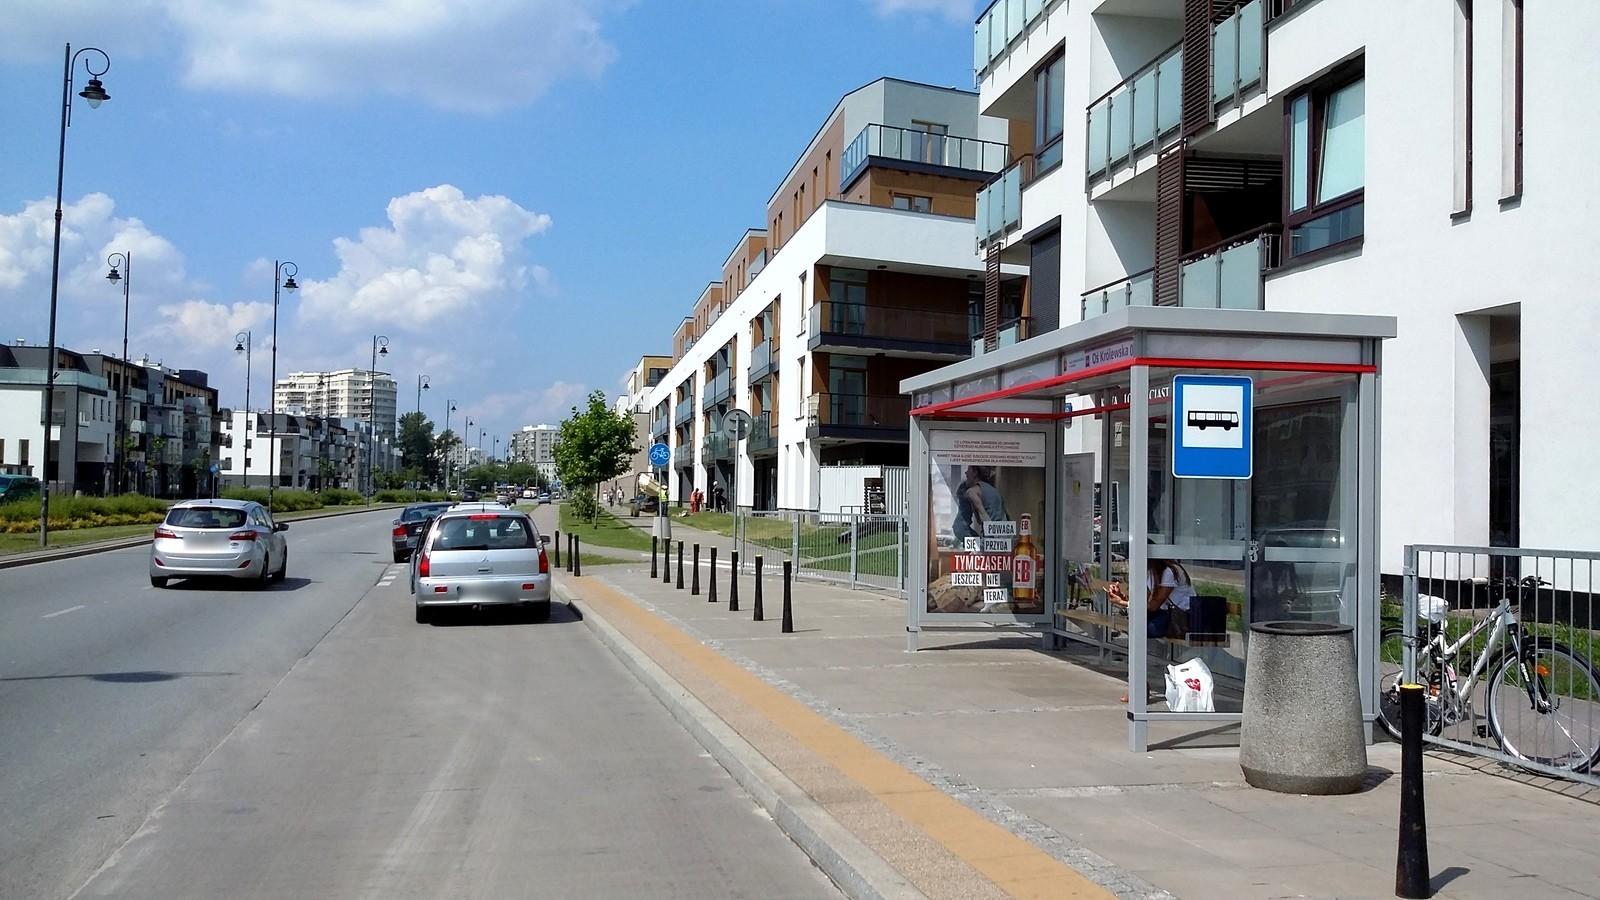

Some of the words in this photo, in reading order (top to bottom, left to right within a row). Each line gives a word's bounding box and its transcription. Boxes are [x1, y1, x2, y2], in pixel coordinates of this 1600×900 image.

[1100, 345, 1129, 361] Królewska
[988, 524, 1014, 535] POWAGA
[1021, 520, 1029, 530] EB
[966, 538, 977, 551] SIĘ
[985, 540, 1008, 551] PRZYDA
[954, 555, 1011, 571] TYMCZASEM
[1015, 560, 1031, 583] EB
[953, 573, 980, 585] JESZCZE
[987, 573, 999, 585] NIE
[985, 590, 1004, 602] TERAZ
